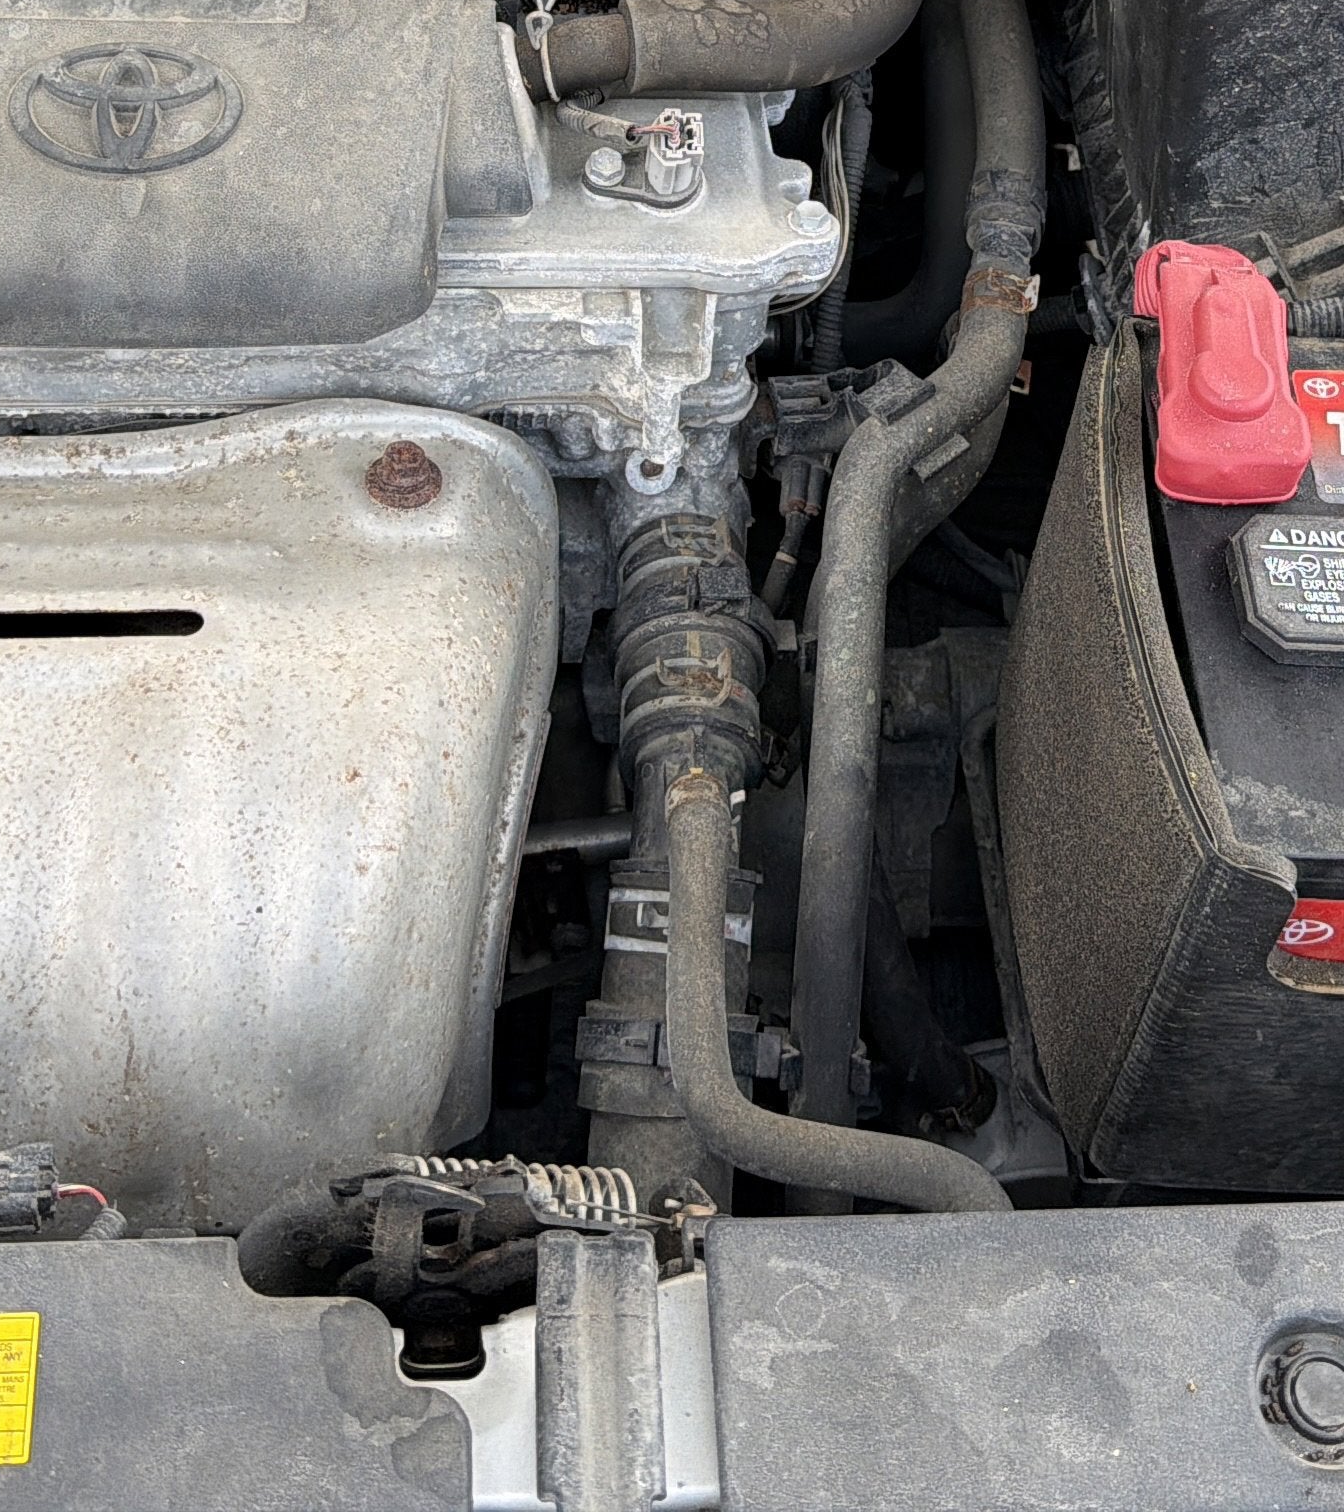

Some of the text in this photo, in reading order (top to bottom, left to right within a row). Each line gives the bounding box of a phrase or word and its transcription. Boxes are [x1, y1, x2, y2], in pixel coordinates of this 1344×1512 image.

[1304, 591, 1341, 603] GASES
[1296, 603, 1325, 614] CAUSE
[2, 1352, 22, 1362] ANY
